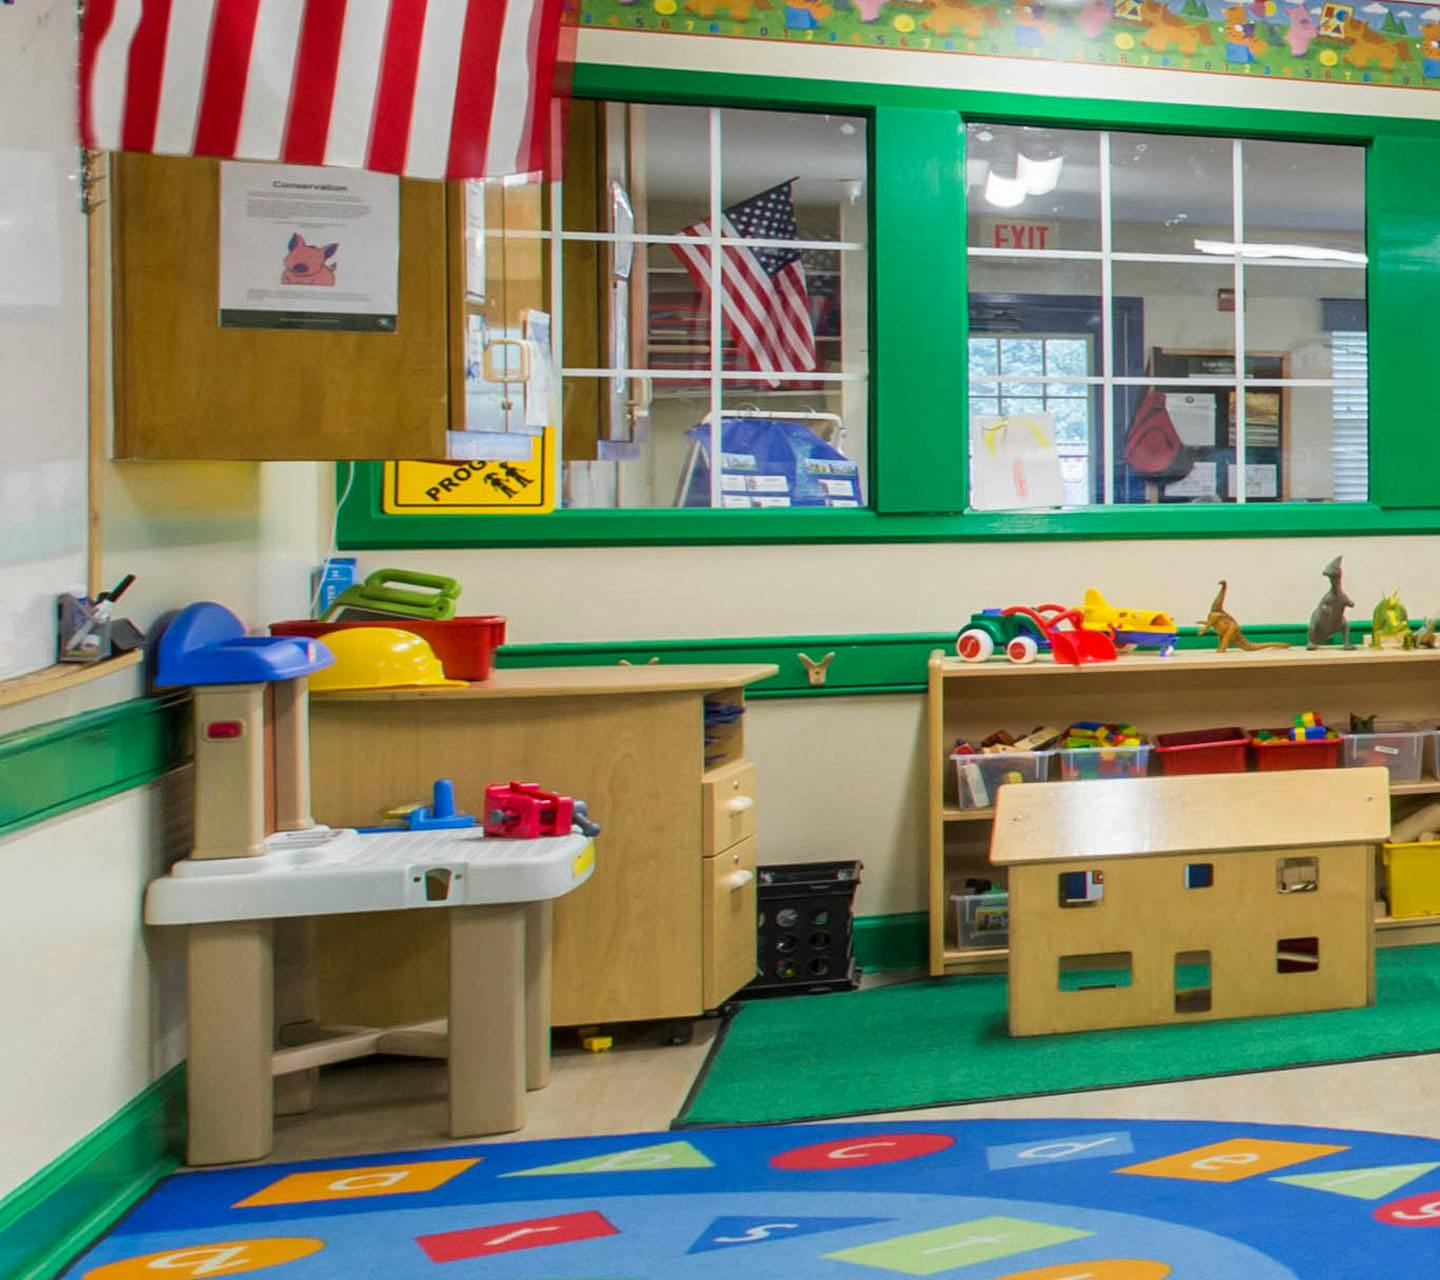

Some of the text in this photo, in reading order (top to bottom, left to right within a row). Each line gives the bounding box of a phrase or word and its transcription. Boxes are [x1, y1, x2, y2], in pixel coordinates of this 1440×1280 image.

[272, 180, 348, 192] Conservation
[424, 460, 488, 502] PROG
[329, 1171, 410, 1192] a
[827, 1141, 897, 1159] c
[1016, 1137, 1104, 1161] d
[1190, 1152, 1260, 1170] e
[147, 1244, 252, 1277] q
[485, 1223, 560, 1249] r
[714, 1222, 800, 1243] s
